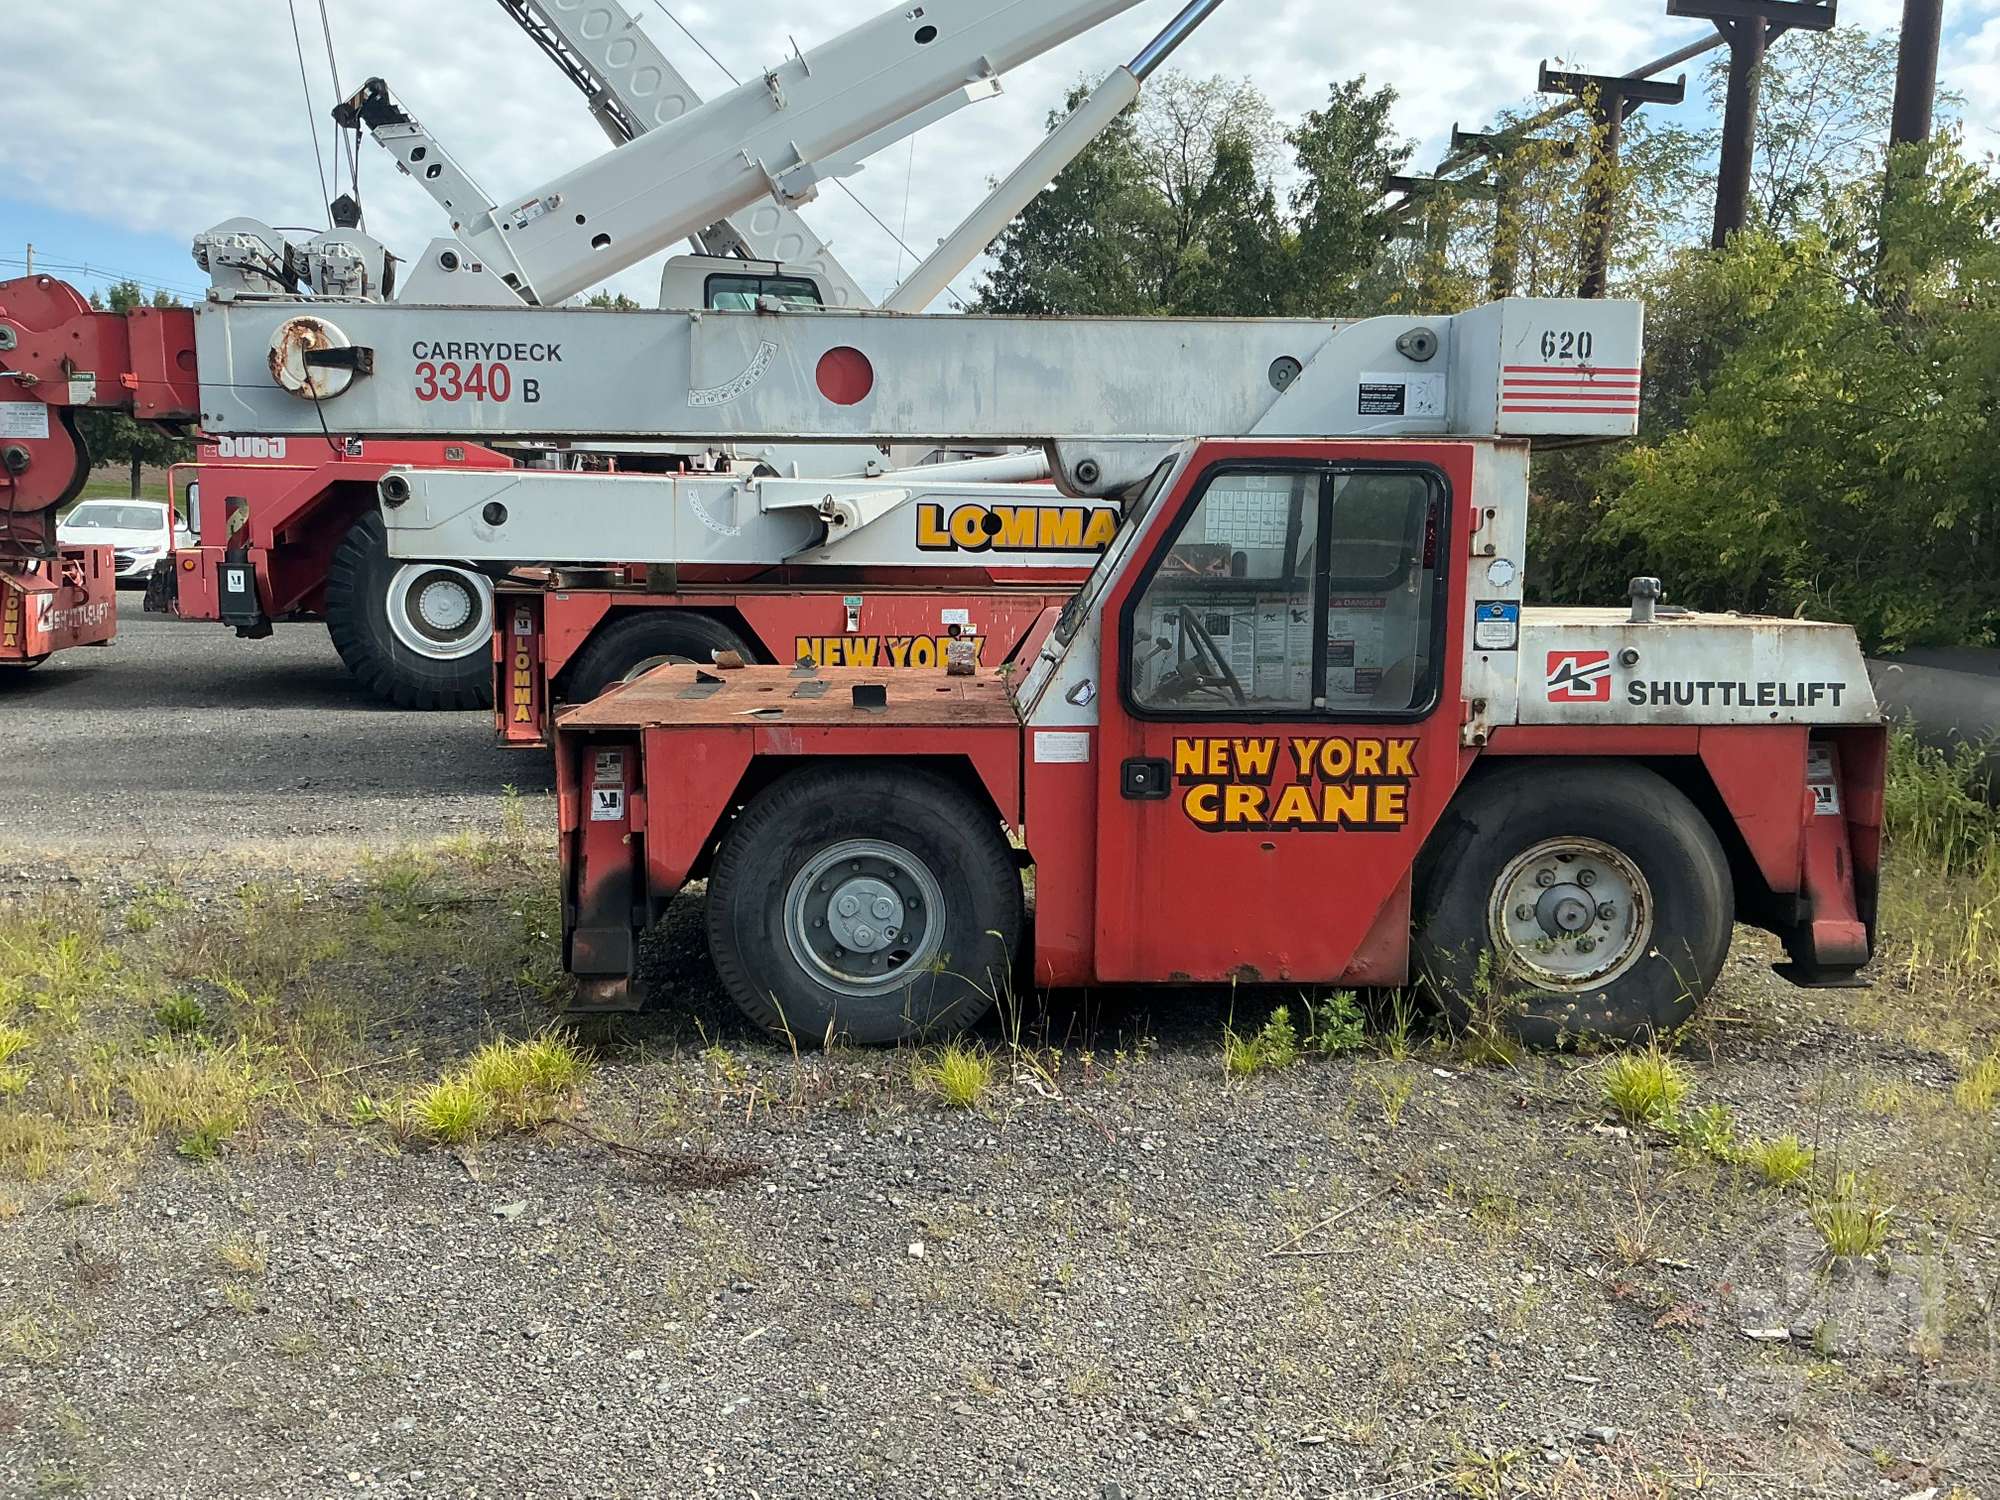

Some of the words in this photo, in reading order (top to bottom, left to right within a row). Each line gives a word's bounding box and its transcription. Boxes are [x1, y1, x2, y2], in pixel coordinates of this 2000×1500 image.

[412, 341, 563, 362] CARRYDECK
[1541, 330, 1592, 360] 620
[415, 361, 512, 402] 3340
[523, 379, 541, 403] B
[916, 503, 1122, 552] LOMMA
[795, 636, 880, 667] NEW
[514, 636, 531, 722] LOMMA
[1627, 680, 1846, 707] SHUTTLELIFT
[1173, 737, 1280, 781] NEW
[1289, 736, 1420, 781] YORK
[1182, 783, 1409, 831] CRANE
